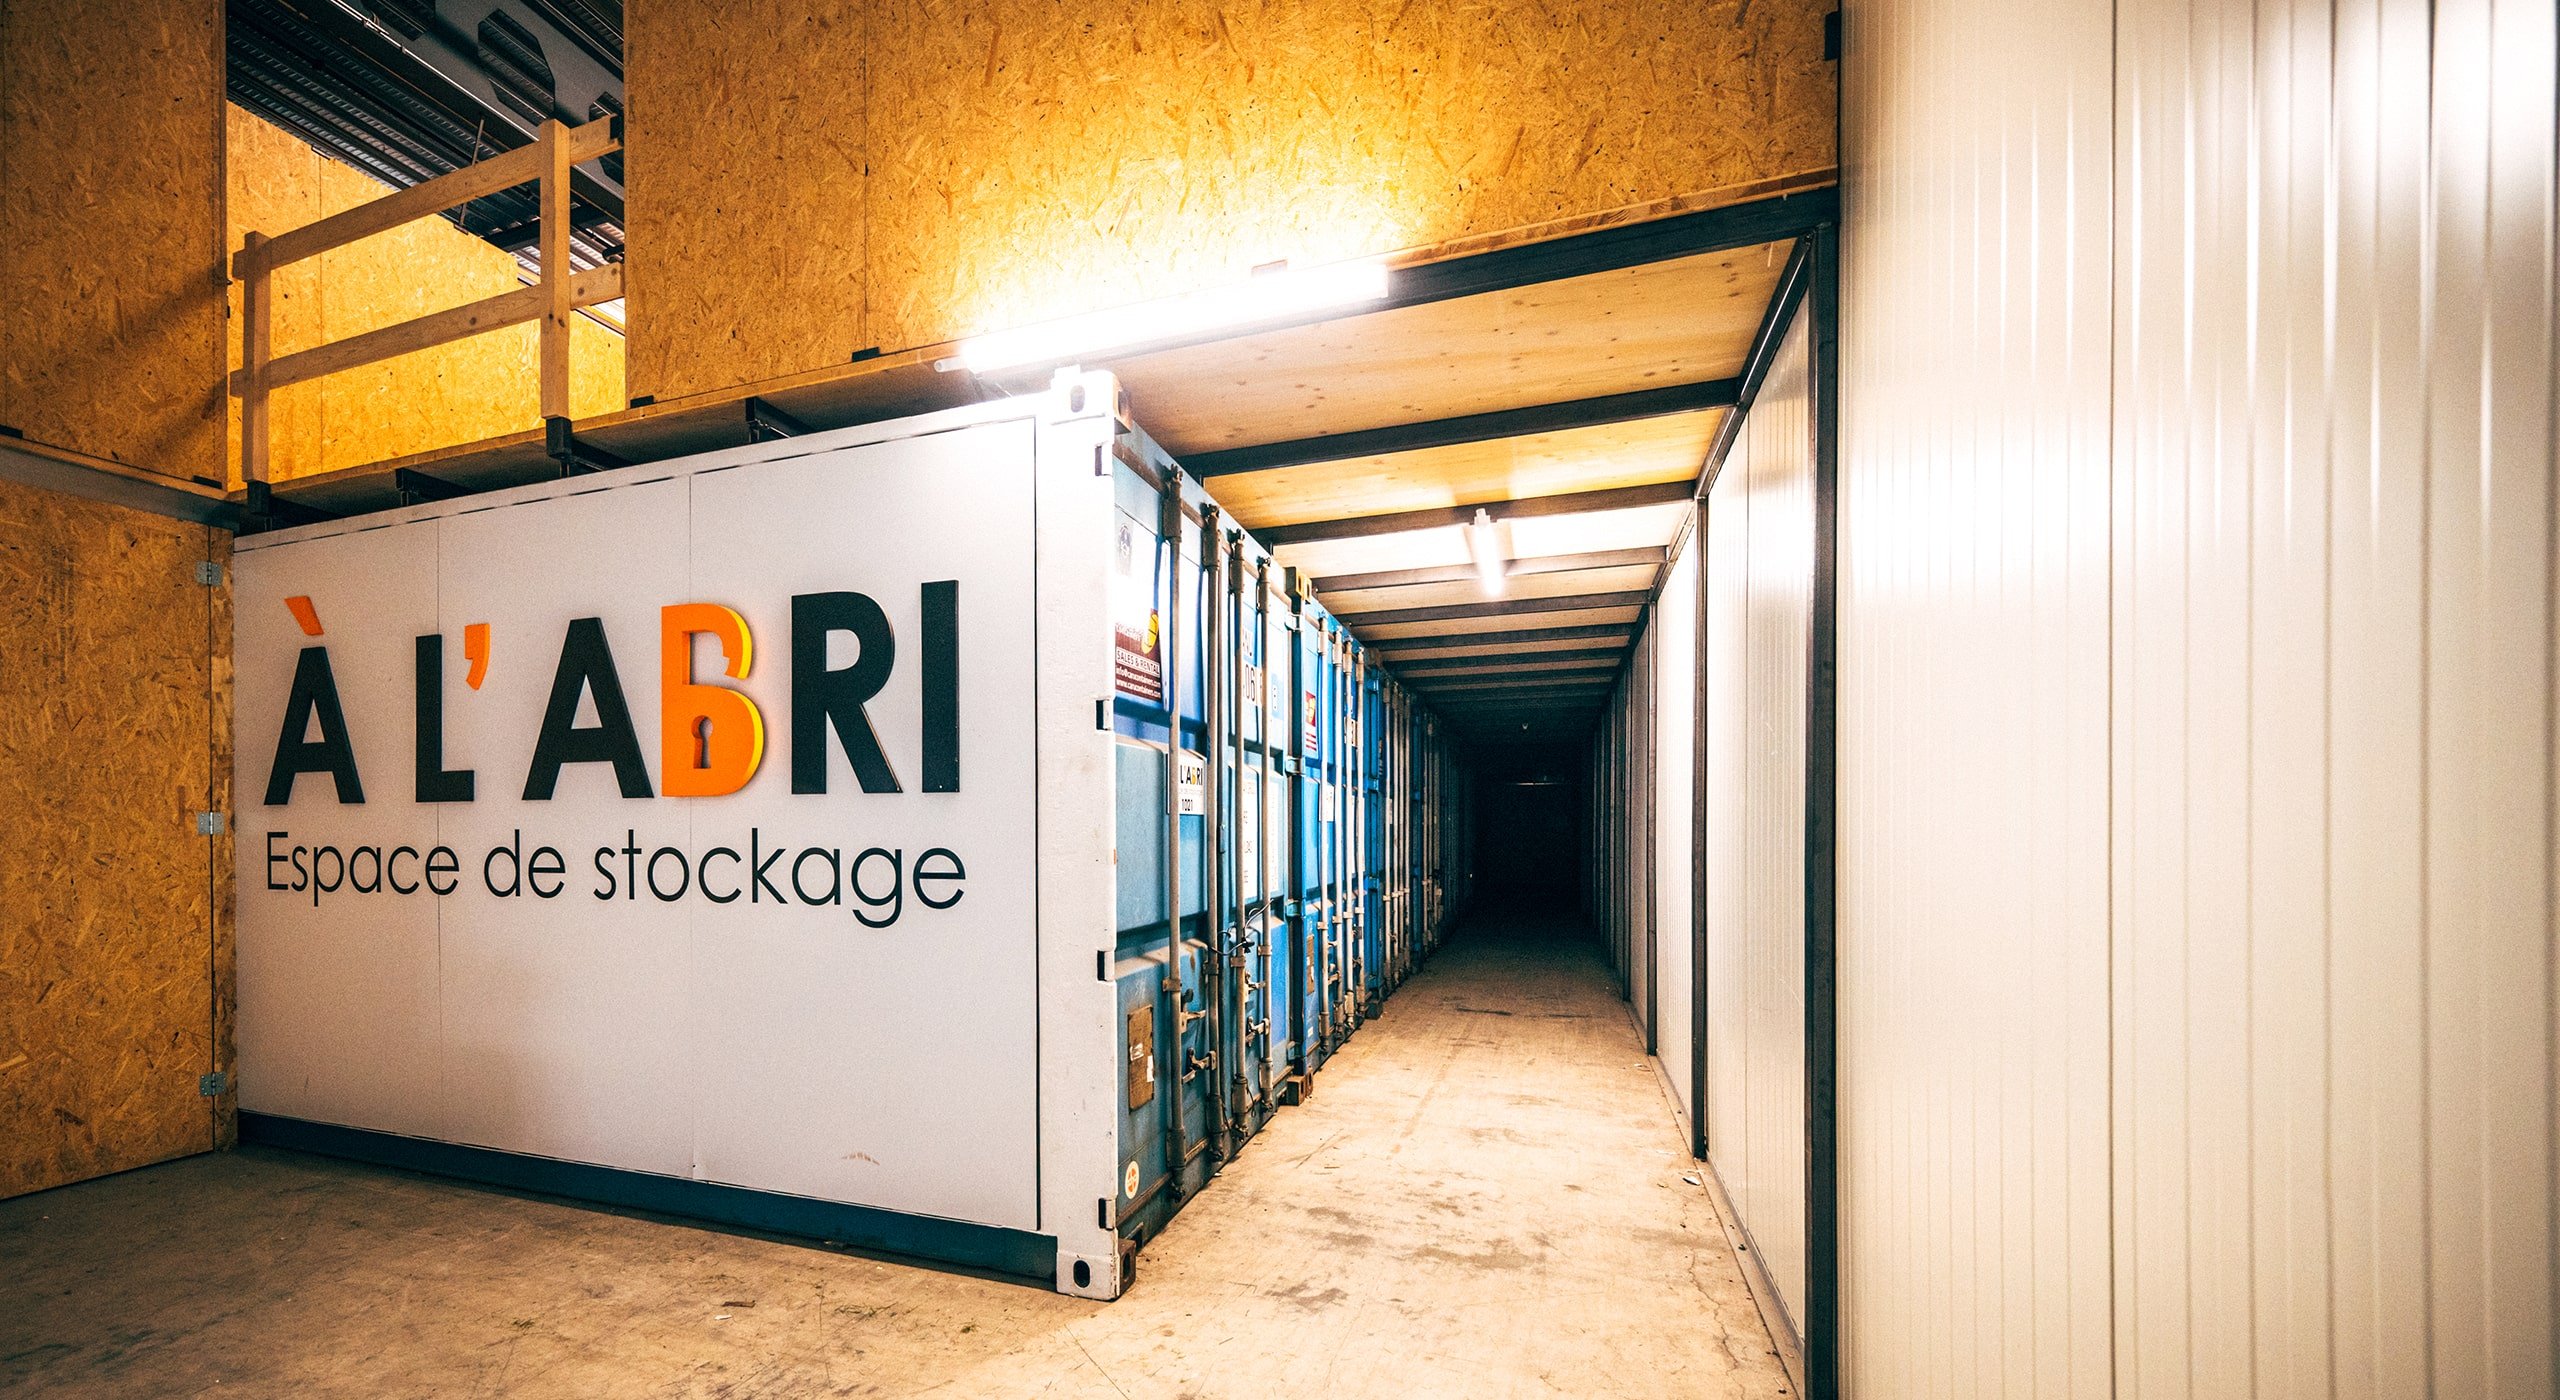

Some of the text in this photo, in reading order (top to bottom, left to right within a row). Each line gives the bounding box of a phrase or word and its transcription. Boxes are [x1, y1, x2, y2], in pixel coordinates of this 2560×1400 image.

[263, 580, 961, 805] À L'ABRI
[1116, 650, 1134, 666] SALES
[266, 827, 967, 929] Espace de stockage
